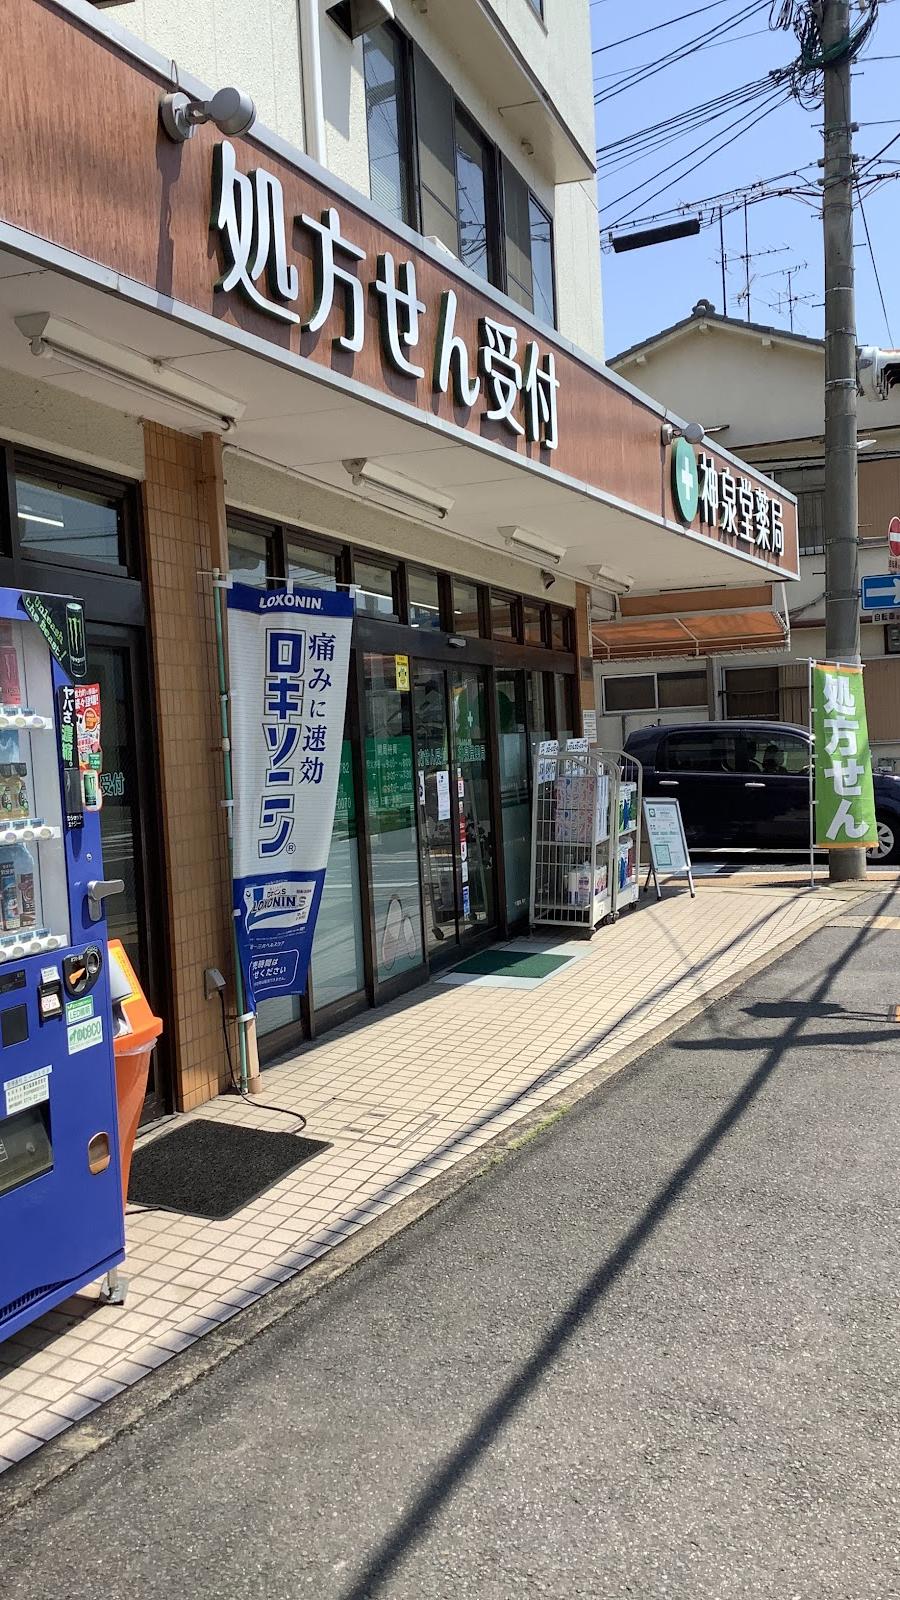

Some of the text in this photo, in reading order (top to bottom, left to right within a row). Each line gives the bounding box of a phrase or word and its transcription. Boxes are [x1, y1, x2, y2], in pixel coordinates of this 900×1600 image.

[213, 140, 560, 450] 処方せん受付
[699, 451, 784, 557] 神泉堂薬局
[259, 594, 322, 610] LOXONIN
[298, 631, 337, 784] 痛みに速効
[823, 673, 869, 841] 処方せん
